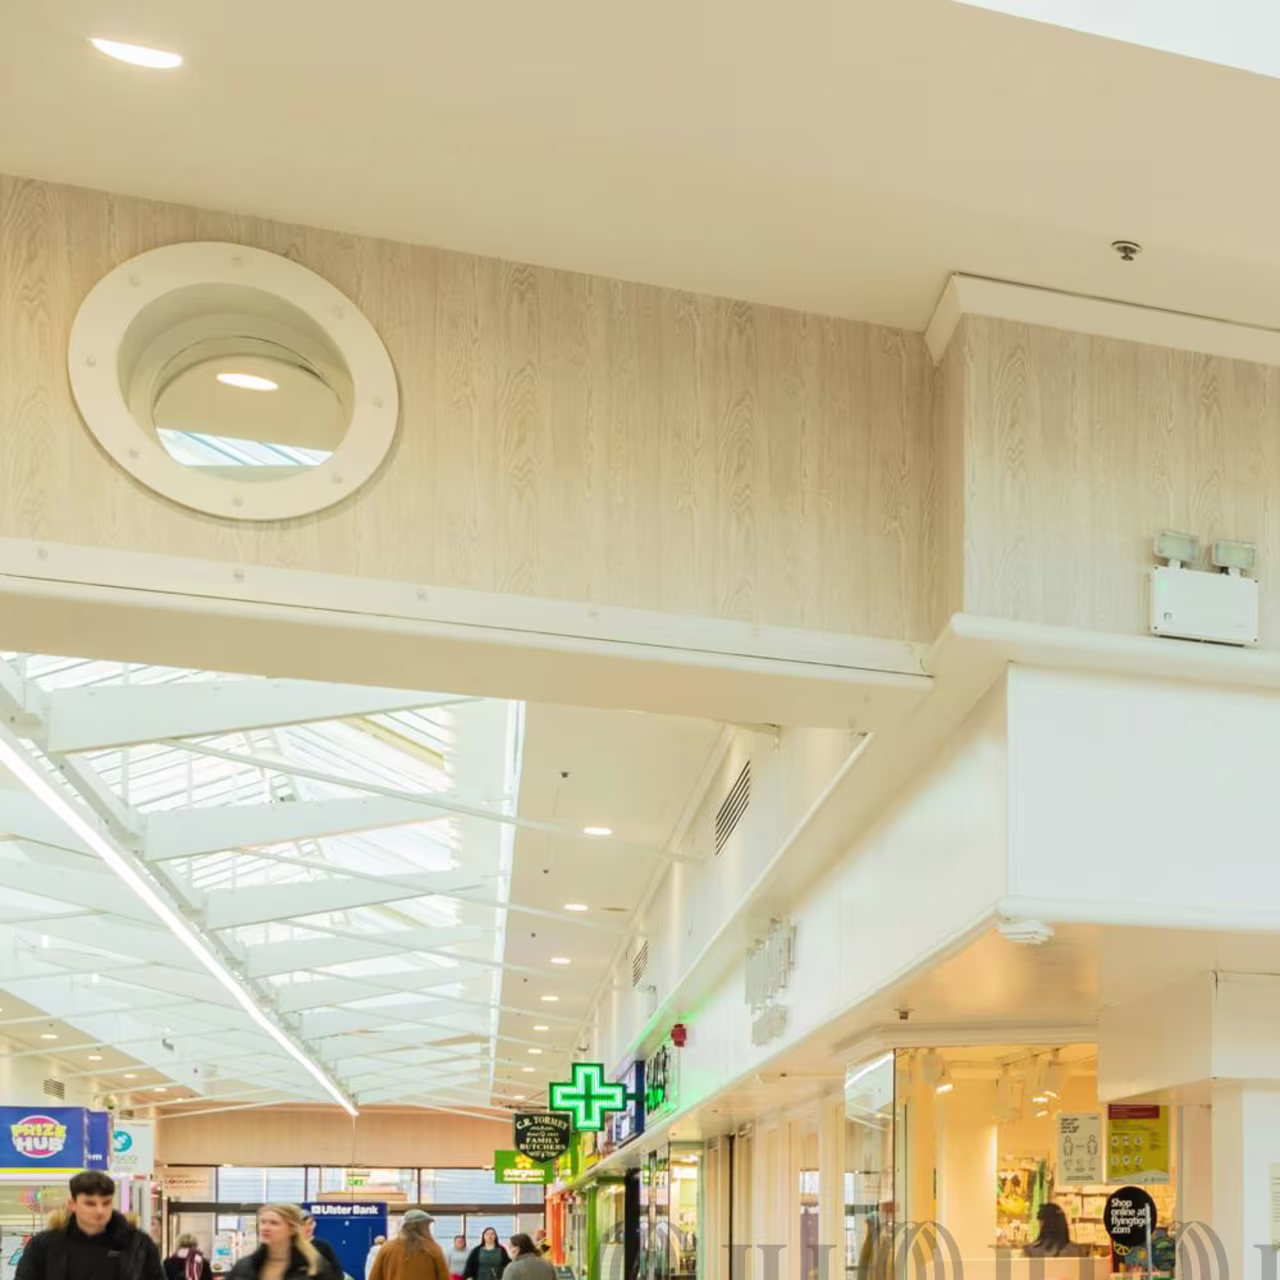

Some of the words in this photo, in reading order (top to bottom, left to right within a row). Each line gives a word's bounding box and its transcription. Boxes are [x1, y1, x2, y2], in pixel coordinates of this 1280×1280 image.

[533, 1116, 568, 1130] TORMEY
[10, 1123, 67, 1139] PRIZE
[14, 1136, 66, 1152] HUB
[1111, 1198, 1132, 1208] Shop
[321, 1204, 352, 1215] Ulster
[353, 1204, 379, 1215] Bank
[1111, 1208, 1135, 1216] online
[1137, 1208, 1146, 1216] at
[1111, 1226, 1131, 1234] .com
